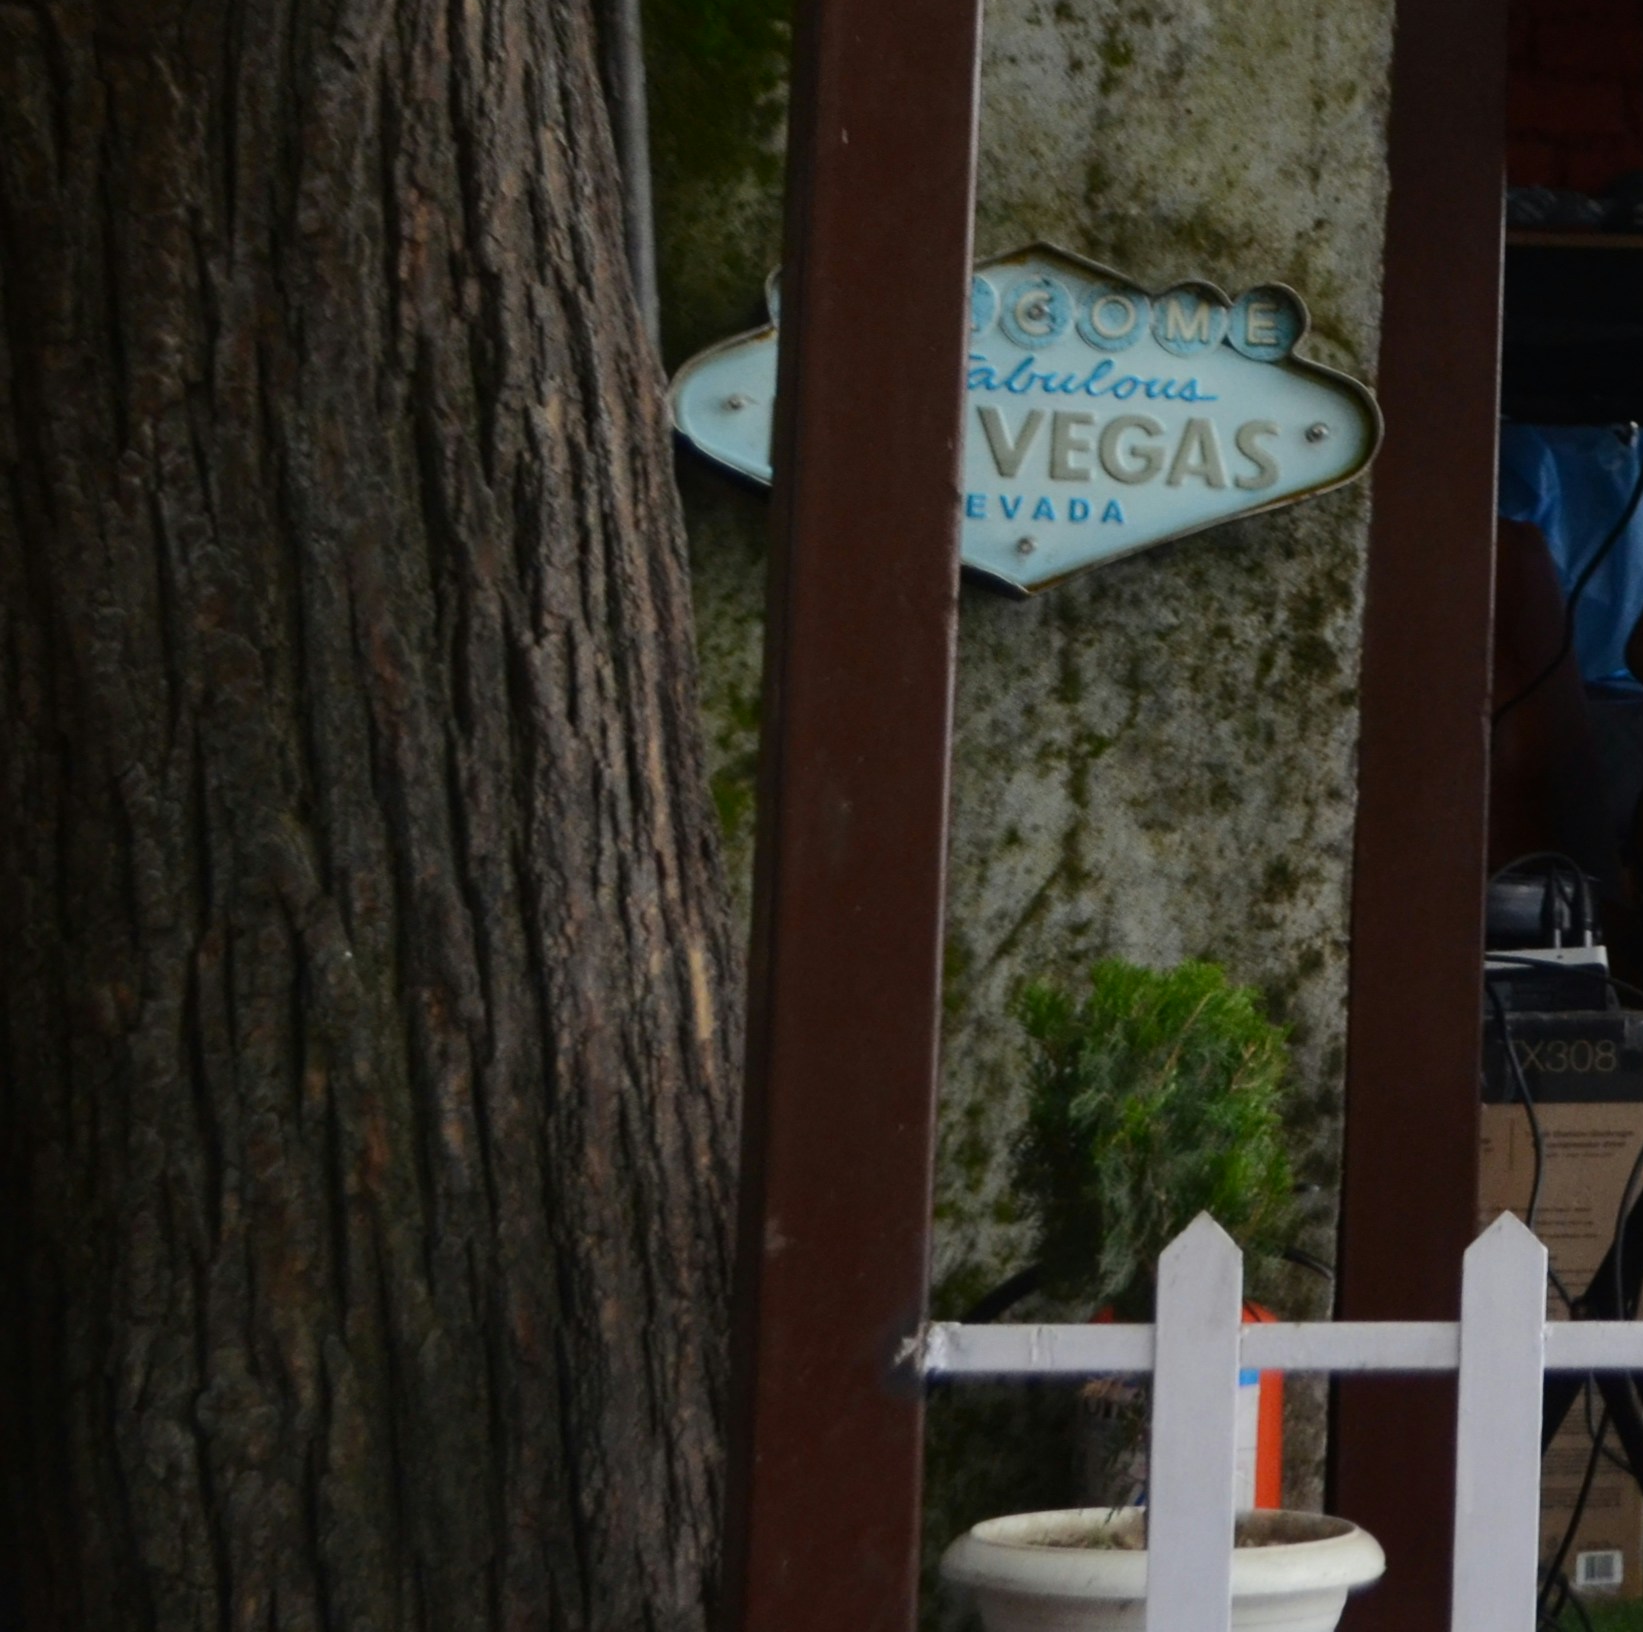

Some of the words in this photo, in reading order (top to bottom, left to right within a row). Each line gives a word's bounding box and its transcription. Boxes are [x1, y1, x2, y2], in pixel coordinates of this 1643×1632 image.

[968, 290, 1281, 347] COME
[967, 355, 1218, 402] abulous
[977, 406, 1280, 490] VEGAS
